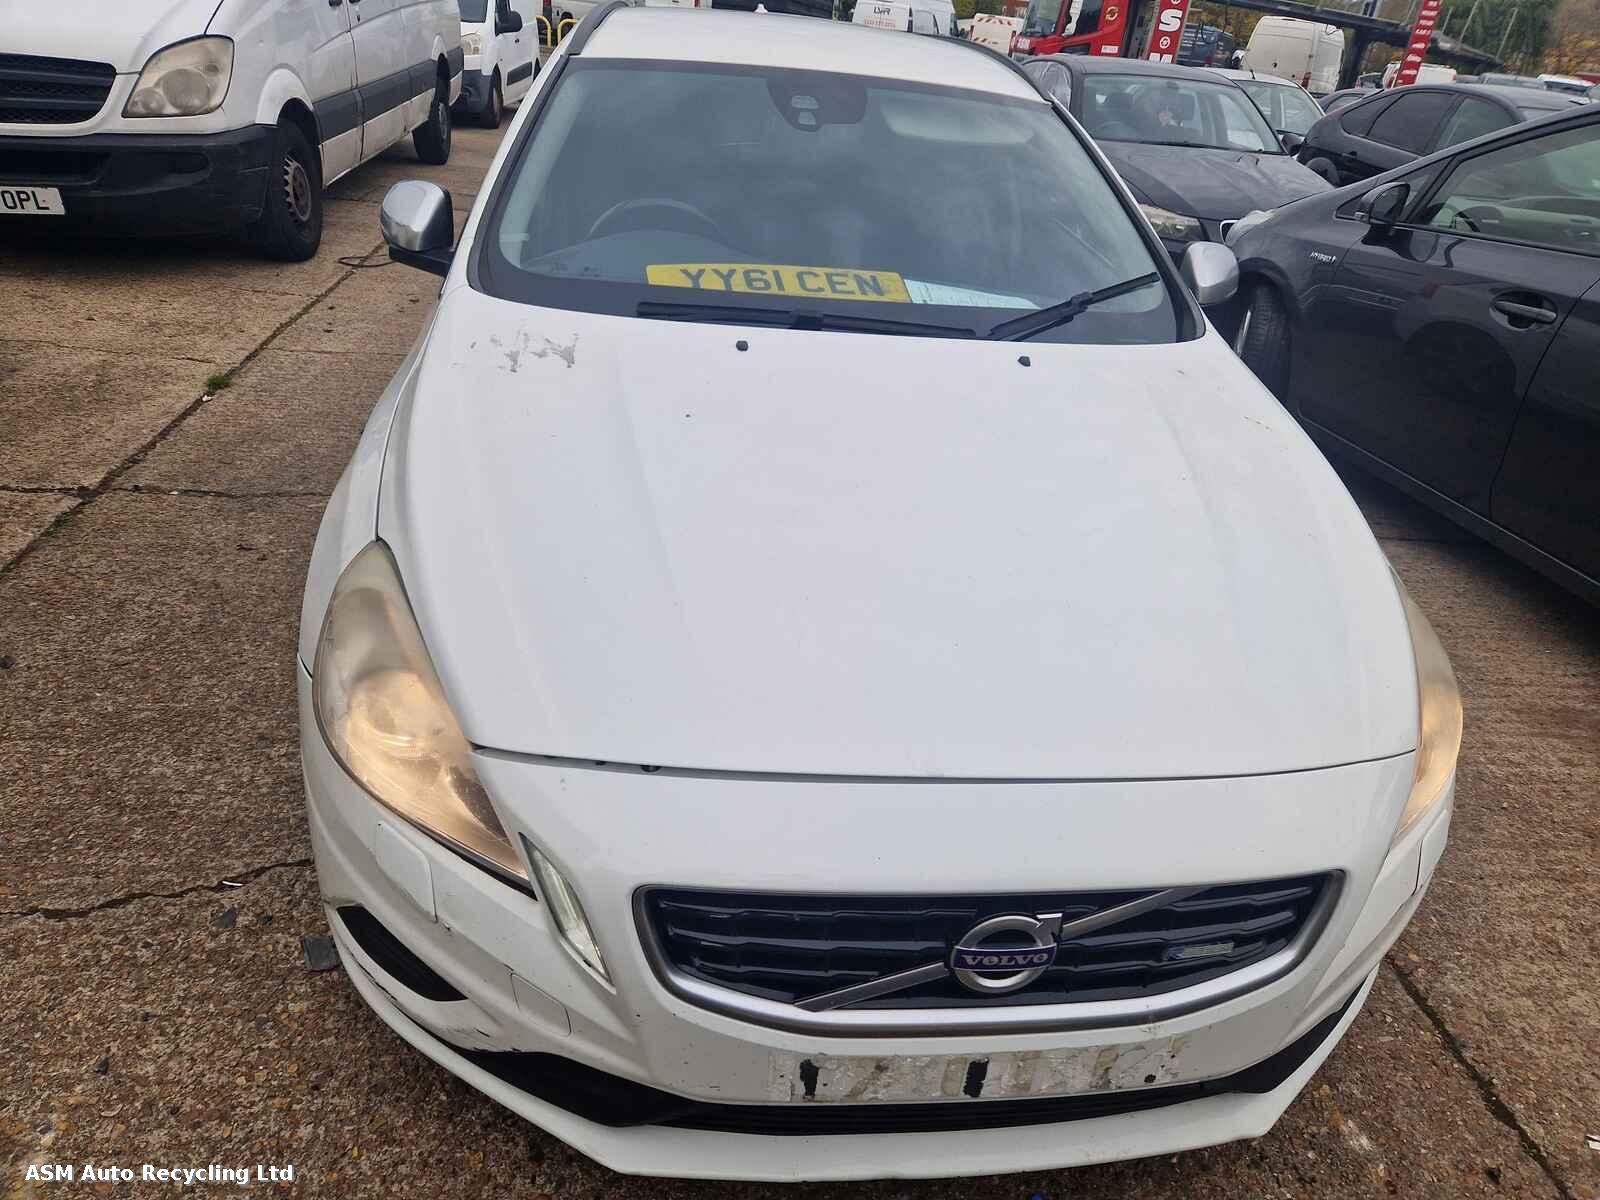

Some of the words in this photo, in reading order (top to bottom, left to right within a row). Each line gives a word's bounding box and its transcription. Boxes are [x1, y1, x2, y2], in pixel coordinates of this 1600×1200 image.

[0, 190, 50, 210] OPL
[680, 268, 785, 293] YY61
[798, 270, 885, 297] CEN
[960, 951, 1049, 967] VOLVO
